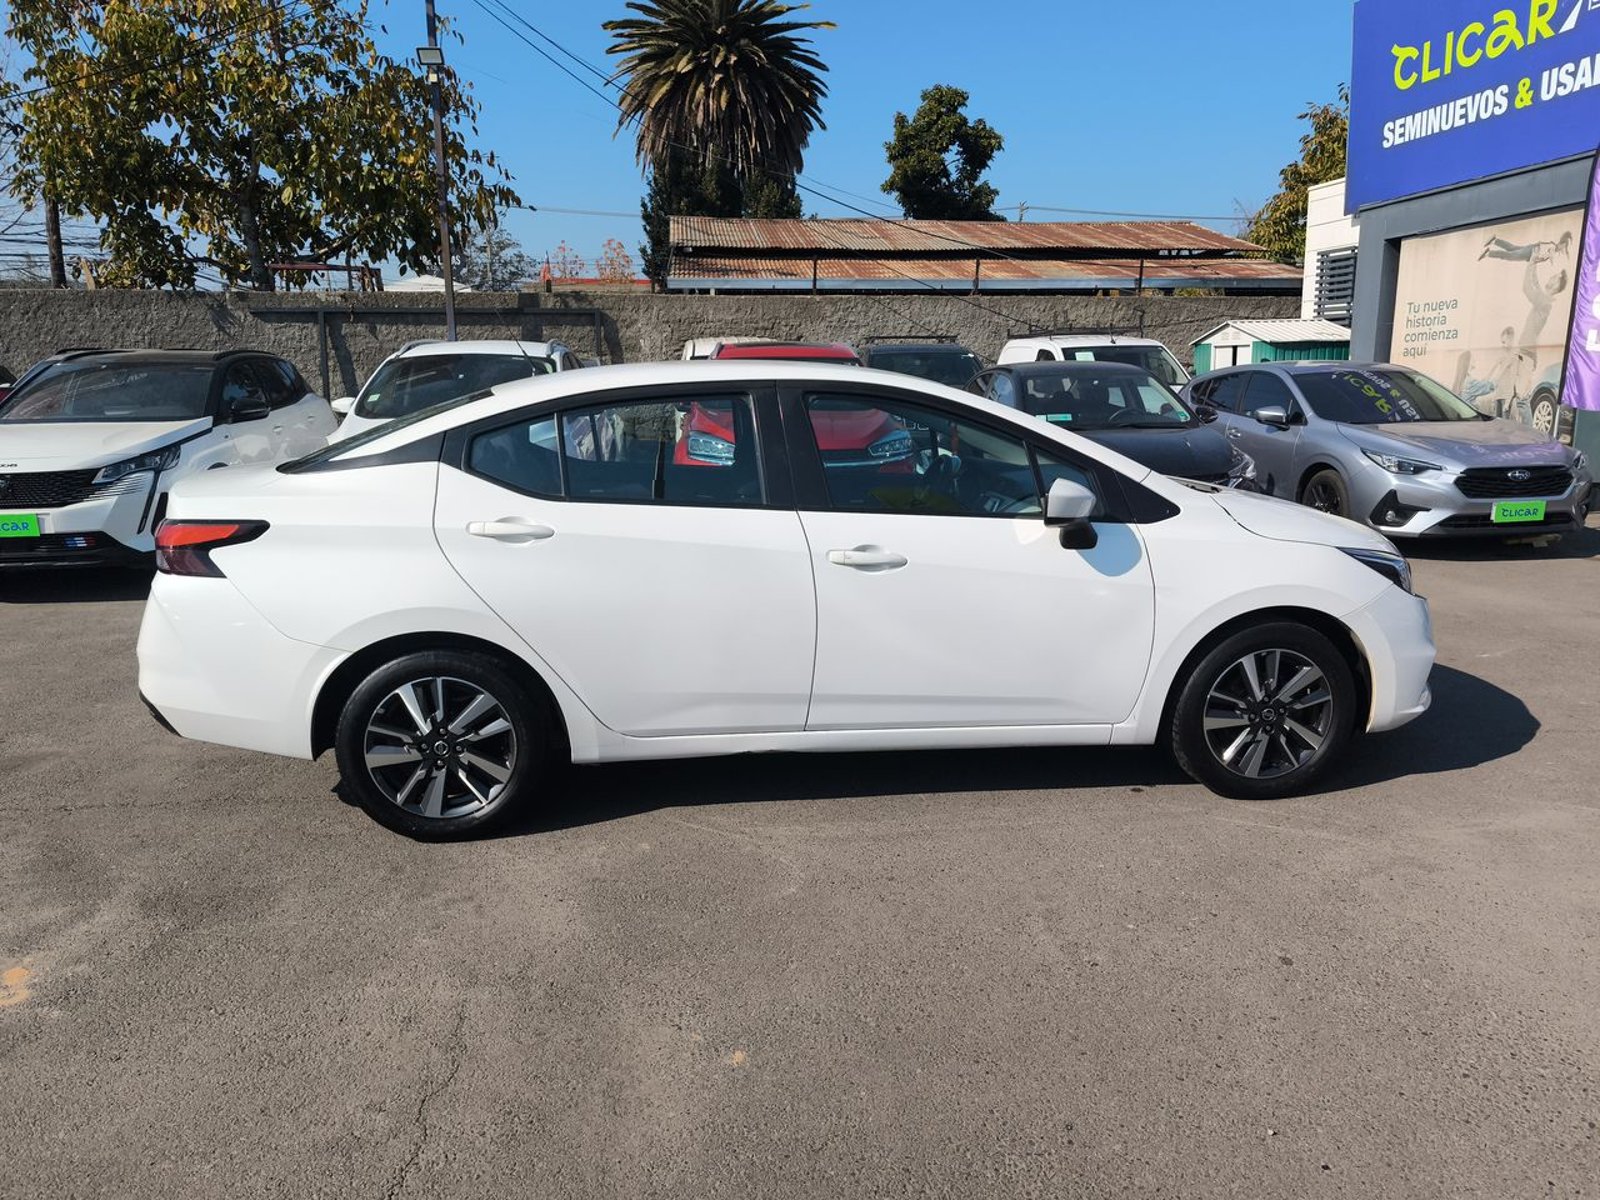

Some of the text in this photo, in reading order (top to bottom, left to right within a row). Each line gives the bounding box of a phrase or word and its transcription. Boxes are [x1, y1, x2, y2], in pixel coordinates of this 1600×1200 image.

[1382, 84, 1509, 149] SEMINUEVOS
[1514, 77, 1534, 110] &
[1407, 299, 1458, 314] Tu nueva
[1405, 312, 1447, 329] historia
[1404, 328, 1459, 343] comienza
